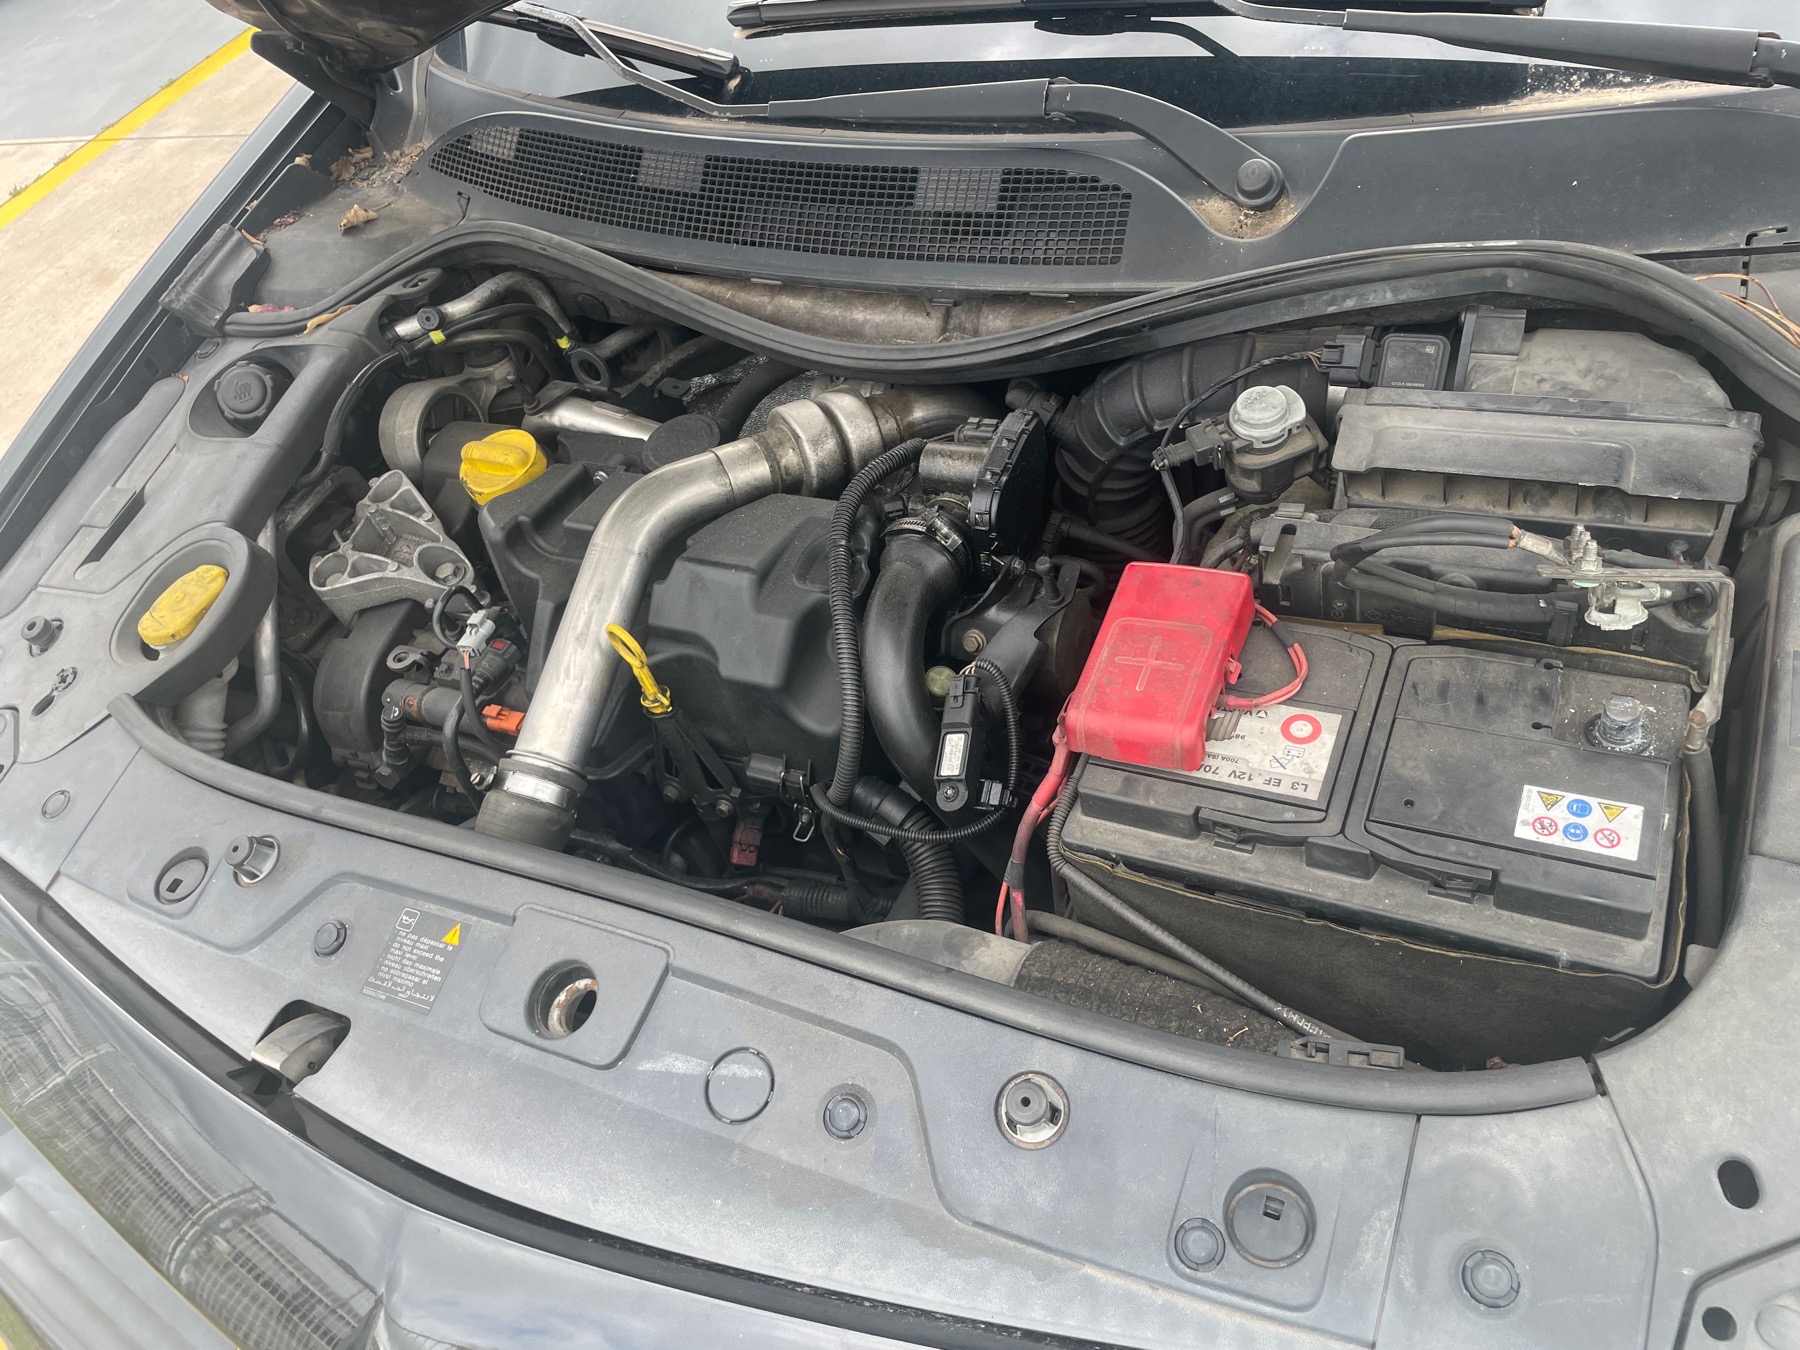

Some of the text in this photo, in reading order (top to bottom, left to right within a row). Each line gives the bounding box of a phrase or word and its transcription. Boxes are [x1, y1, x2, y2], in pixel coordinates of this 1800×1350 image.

[1228, 769, 1254, 782] 12V
[1263, 777, 1282, 788] EF
[1290, 781, 1309, 792] L3
[396, 936, 429, 950] niveau maxi
[420, 936, 446, 949] dépasser
[404, 951, 418, 960] level
[413, 948, 434, 959] exceed
[384, 960, 402, 970] niveau
[387, 954, 441, 975] nicht das maximale
[378, 971, 392, 980] nivel
